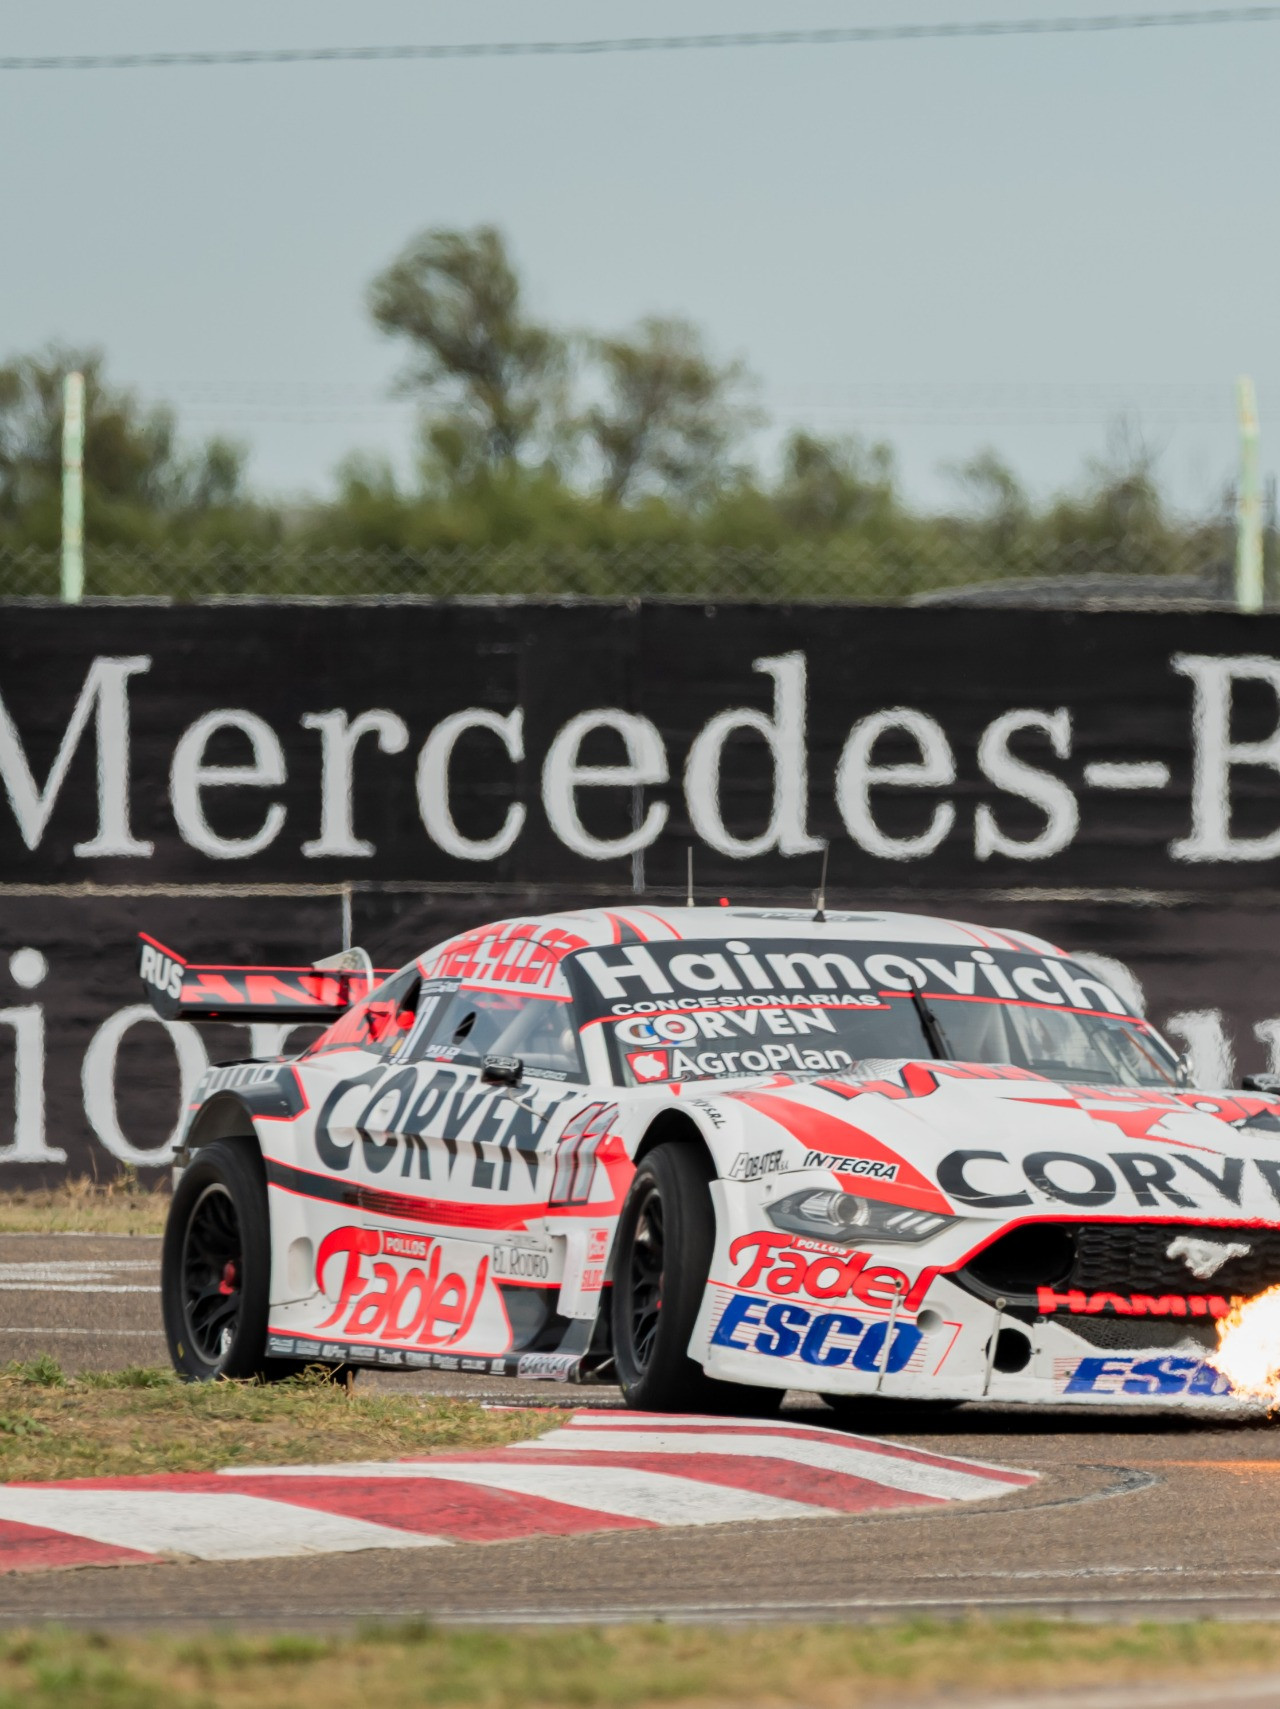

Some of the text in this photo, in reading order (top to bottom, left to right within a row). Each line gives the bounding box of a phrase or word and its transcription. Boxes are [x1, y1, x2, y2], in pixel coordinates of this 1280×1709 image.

[140, 944, 184, 999] RUS
[575, 941, 1128, 1016] Haimovich
[611, 994, 881, 1016] CONCESIONARIAS
[614, 1008, 838, 1046] CORVEN
[672, 1044, 853, 1077] AgroPlan
[315, 1065, 574, 1192] CORVEN
[802, 1150, 898, 1180] INTEGRA
[386, 1236, 427, 1257] POLLOS
[796, 1238, 848, 1255] POLLOS
[315, 1226, 489, 1346] Fadel
[729, 1231, 942, 1312] Fadel
[710, 1294, 924, 1373] ESCO
